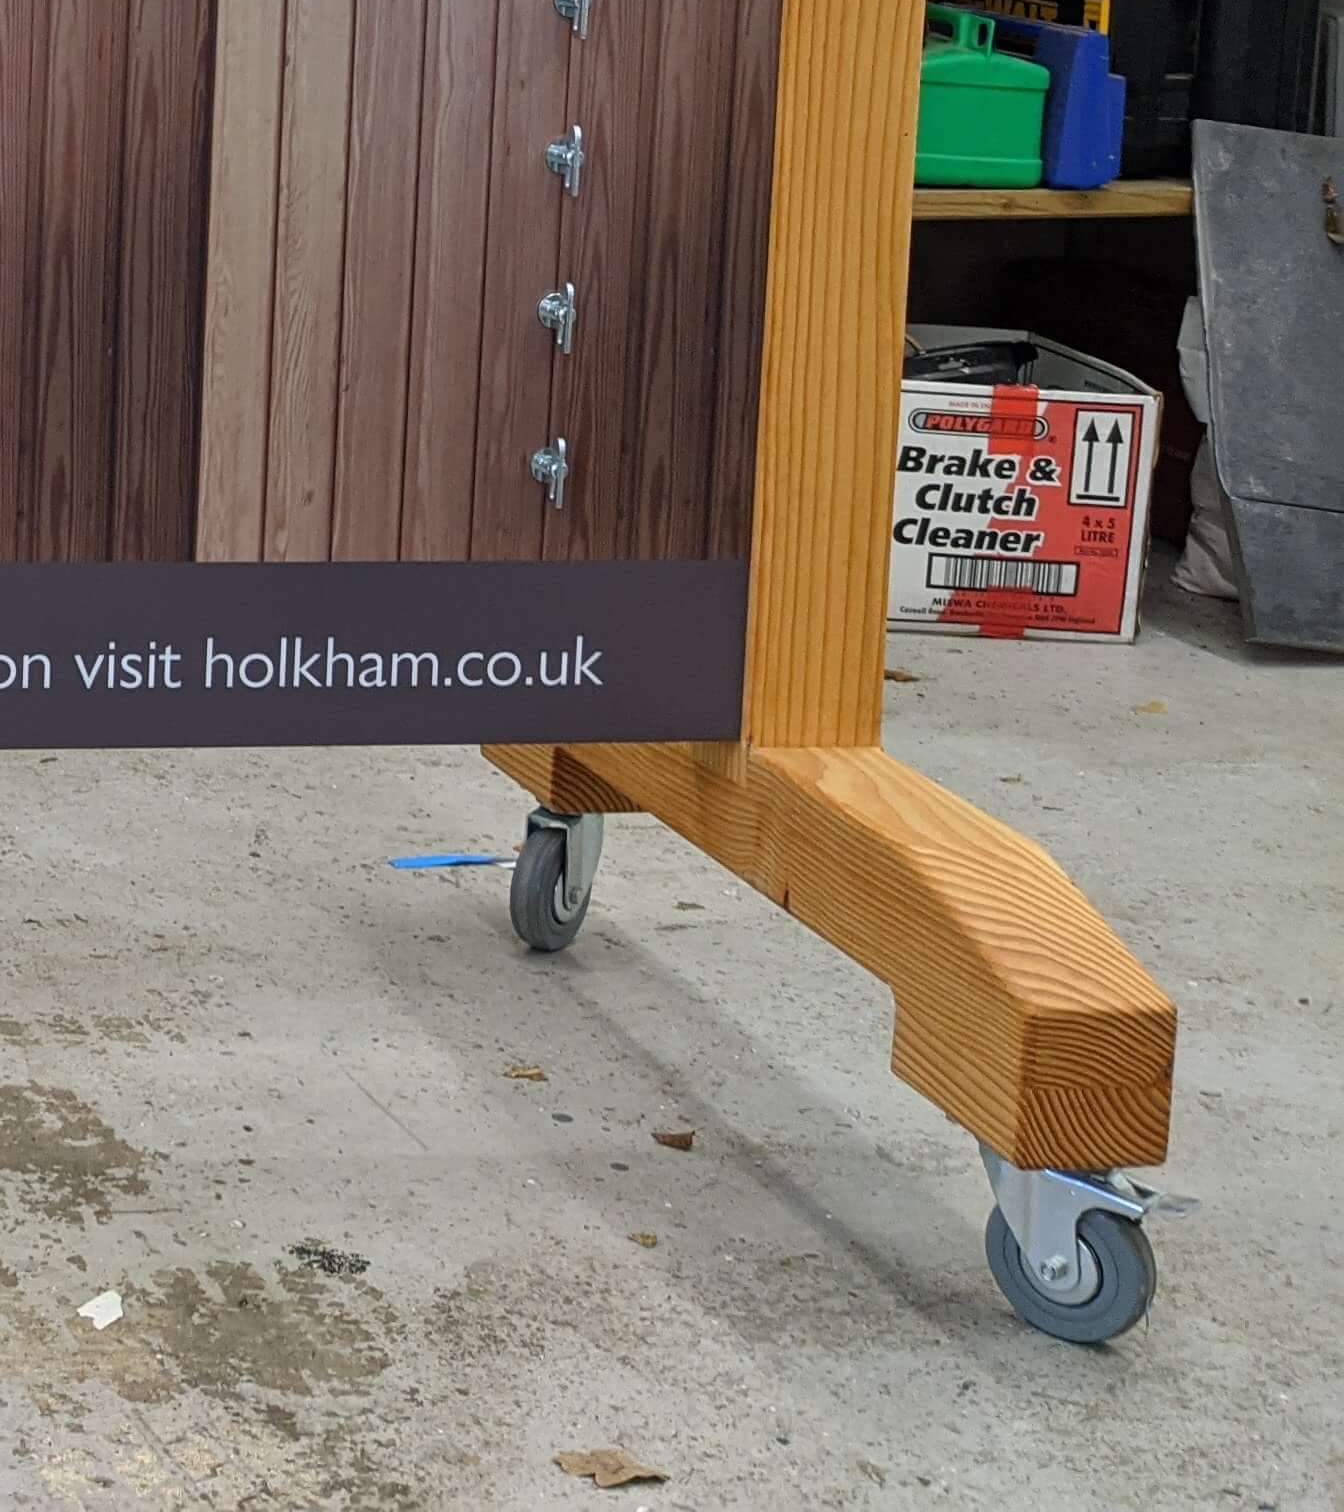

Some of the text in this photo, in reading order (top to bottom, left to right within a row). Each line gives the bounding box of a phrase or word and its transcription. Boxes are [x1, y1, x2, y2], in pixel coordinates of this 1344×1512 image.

[925, 413, 1034, 435] POLYGARD
[897, 445, 1058, 482] Brake &
[915, 483, 1037, 517] Clutch
[893, 517, 1041, 553] Cleaner
[1081, 530, 1116, 544] LITRE
[1082, 516, 1116, 530] 4 x 5
[74, 641, 182, 689] visit
[205, 635, 603, 688] holkham.co.uk
